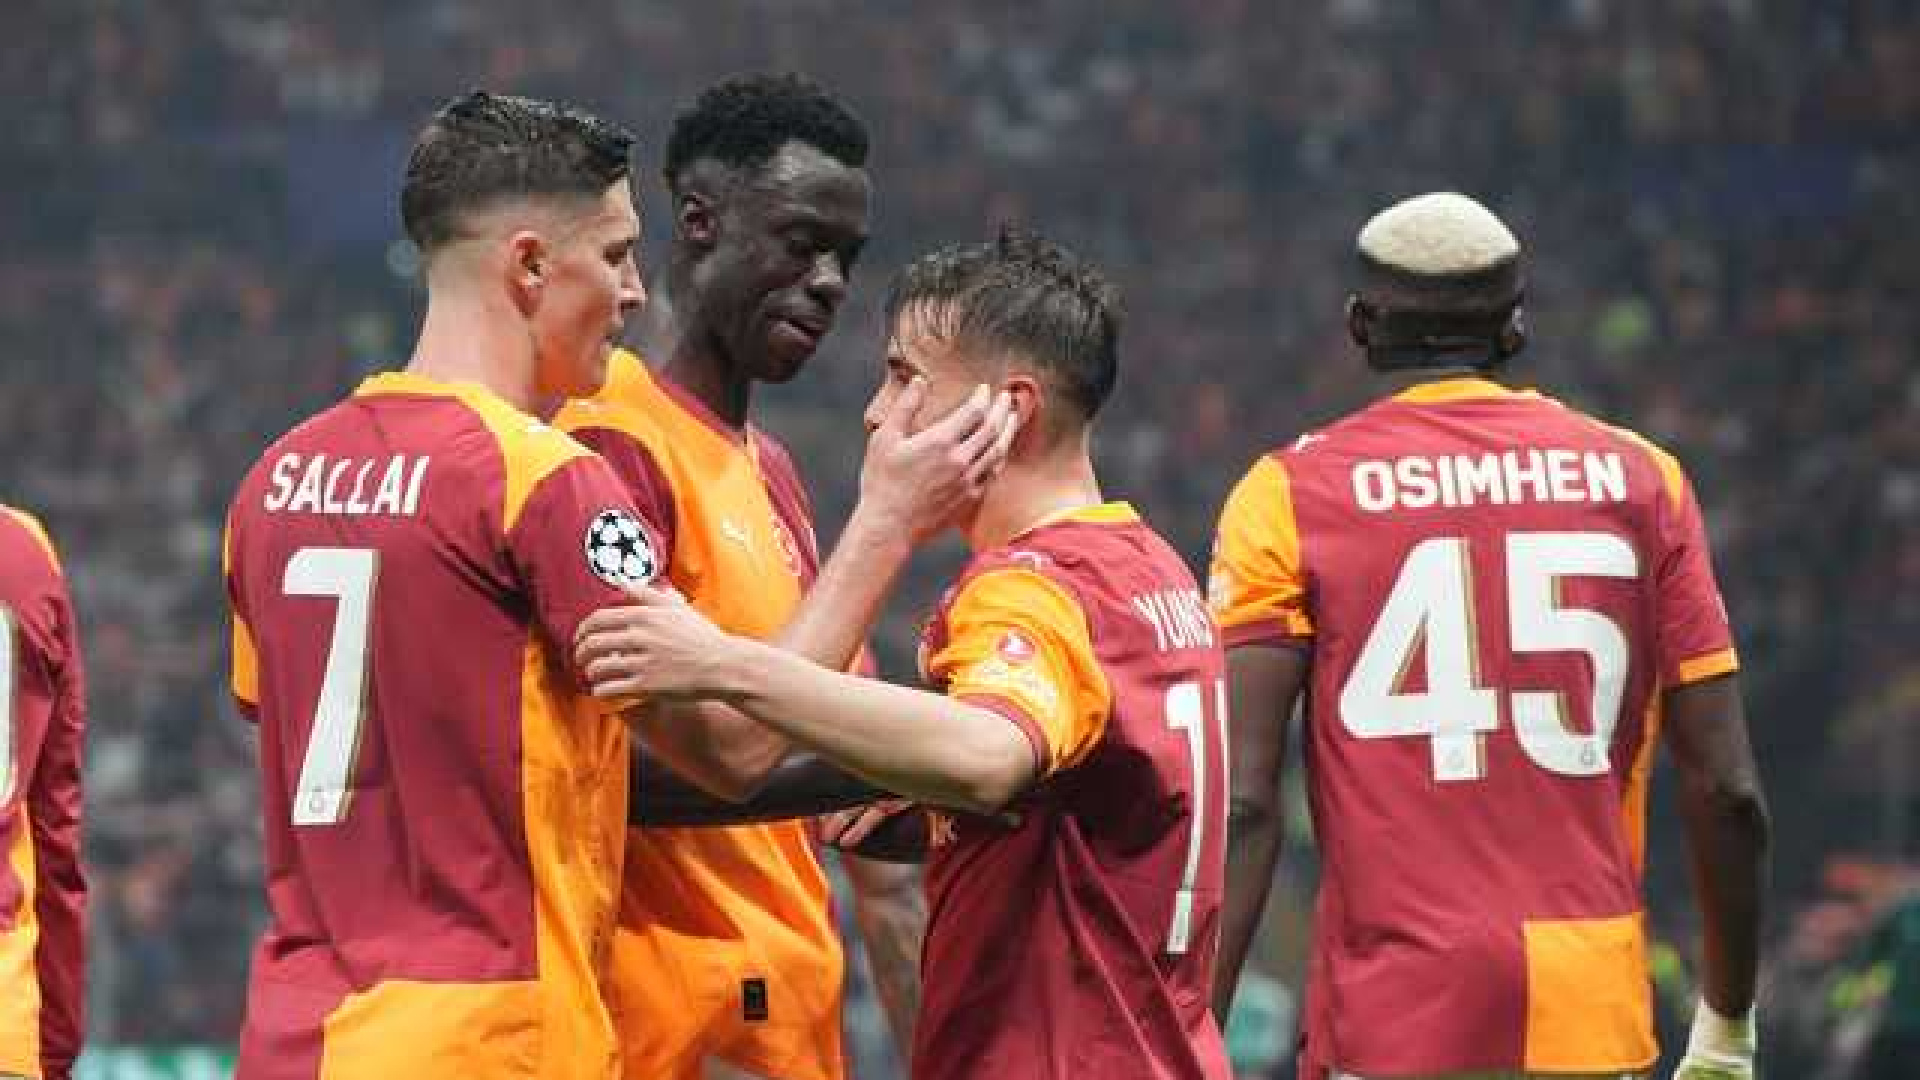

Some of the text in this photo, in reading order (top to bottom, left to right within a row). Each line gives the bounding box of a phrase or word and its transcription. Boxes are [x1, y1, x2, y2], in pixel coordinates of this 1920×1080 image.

[264, 452, 430, 517] SALLAI
[1353, 449, 1627, 512] OSIMHEN
[282, 547, 379, 825] 7
[1339, 531, 1639, 780] 45
